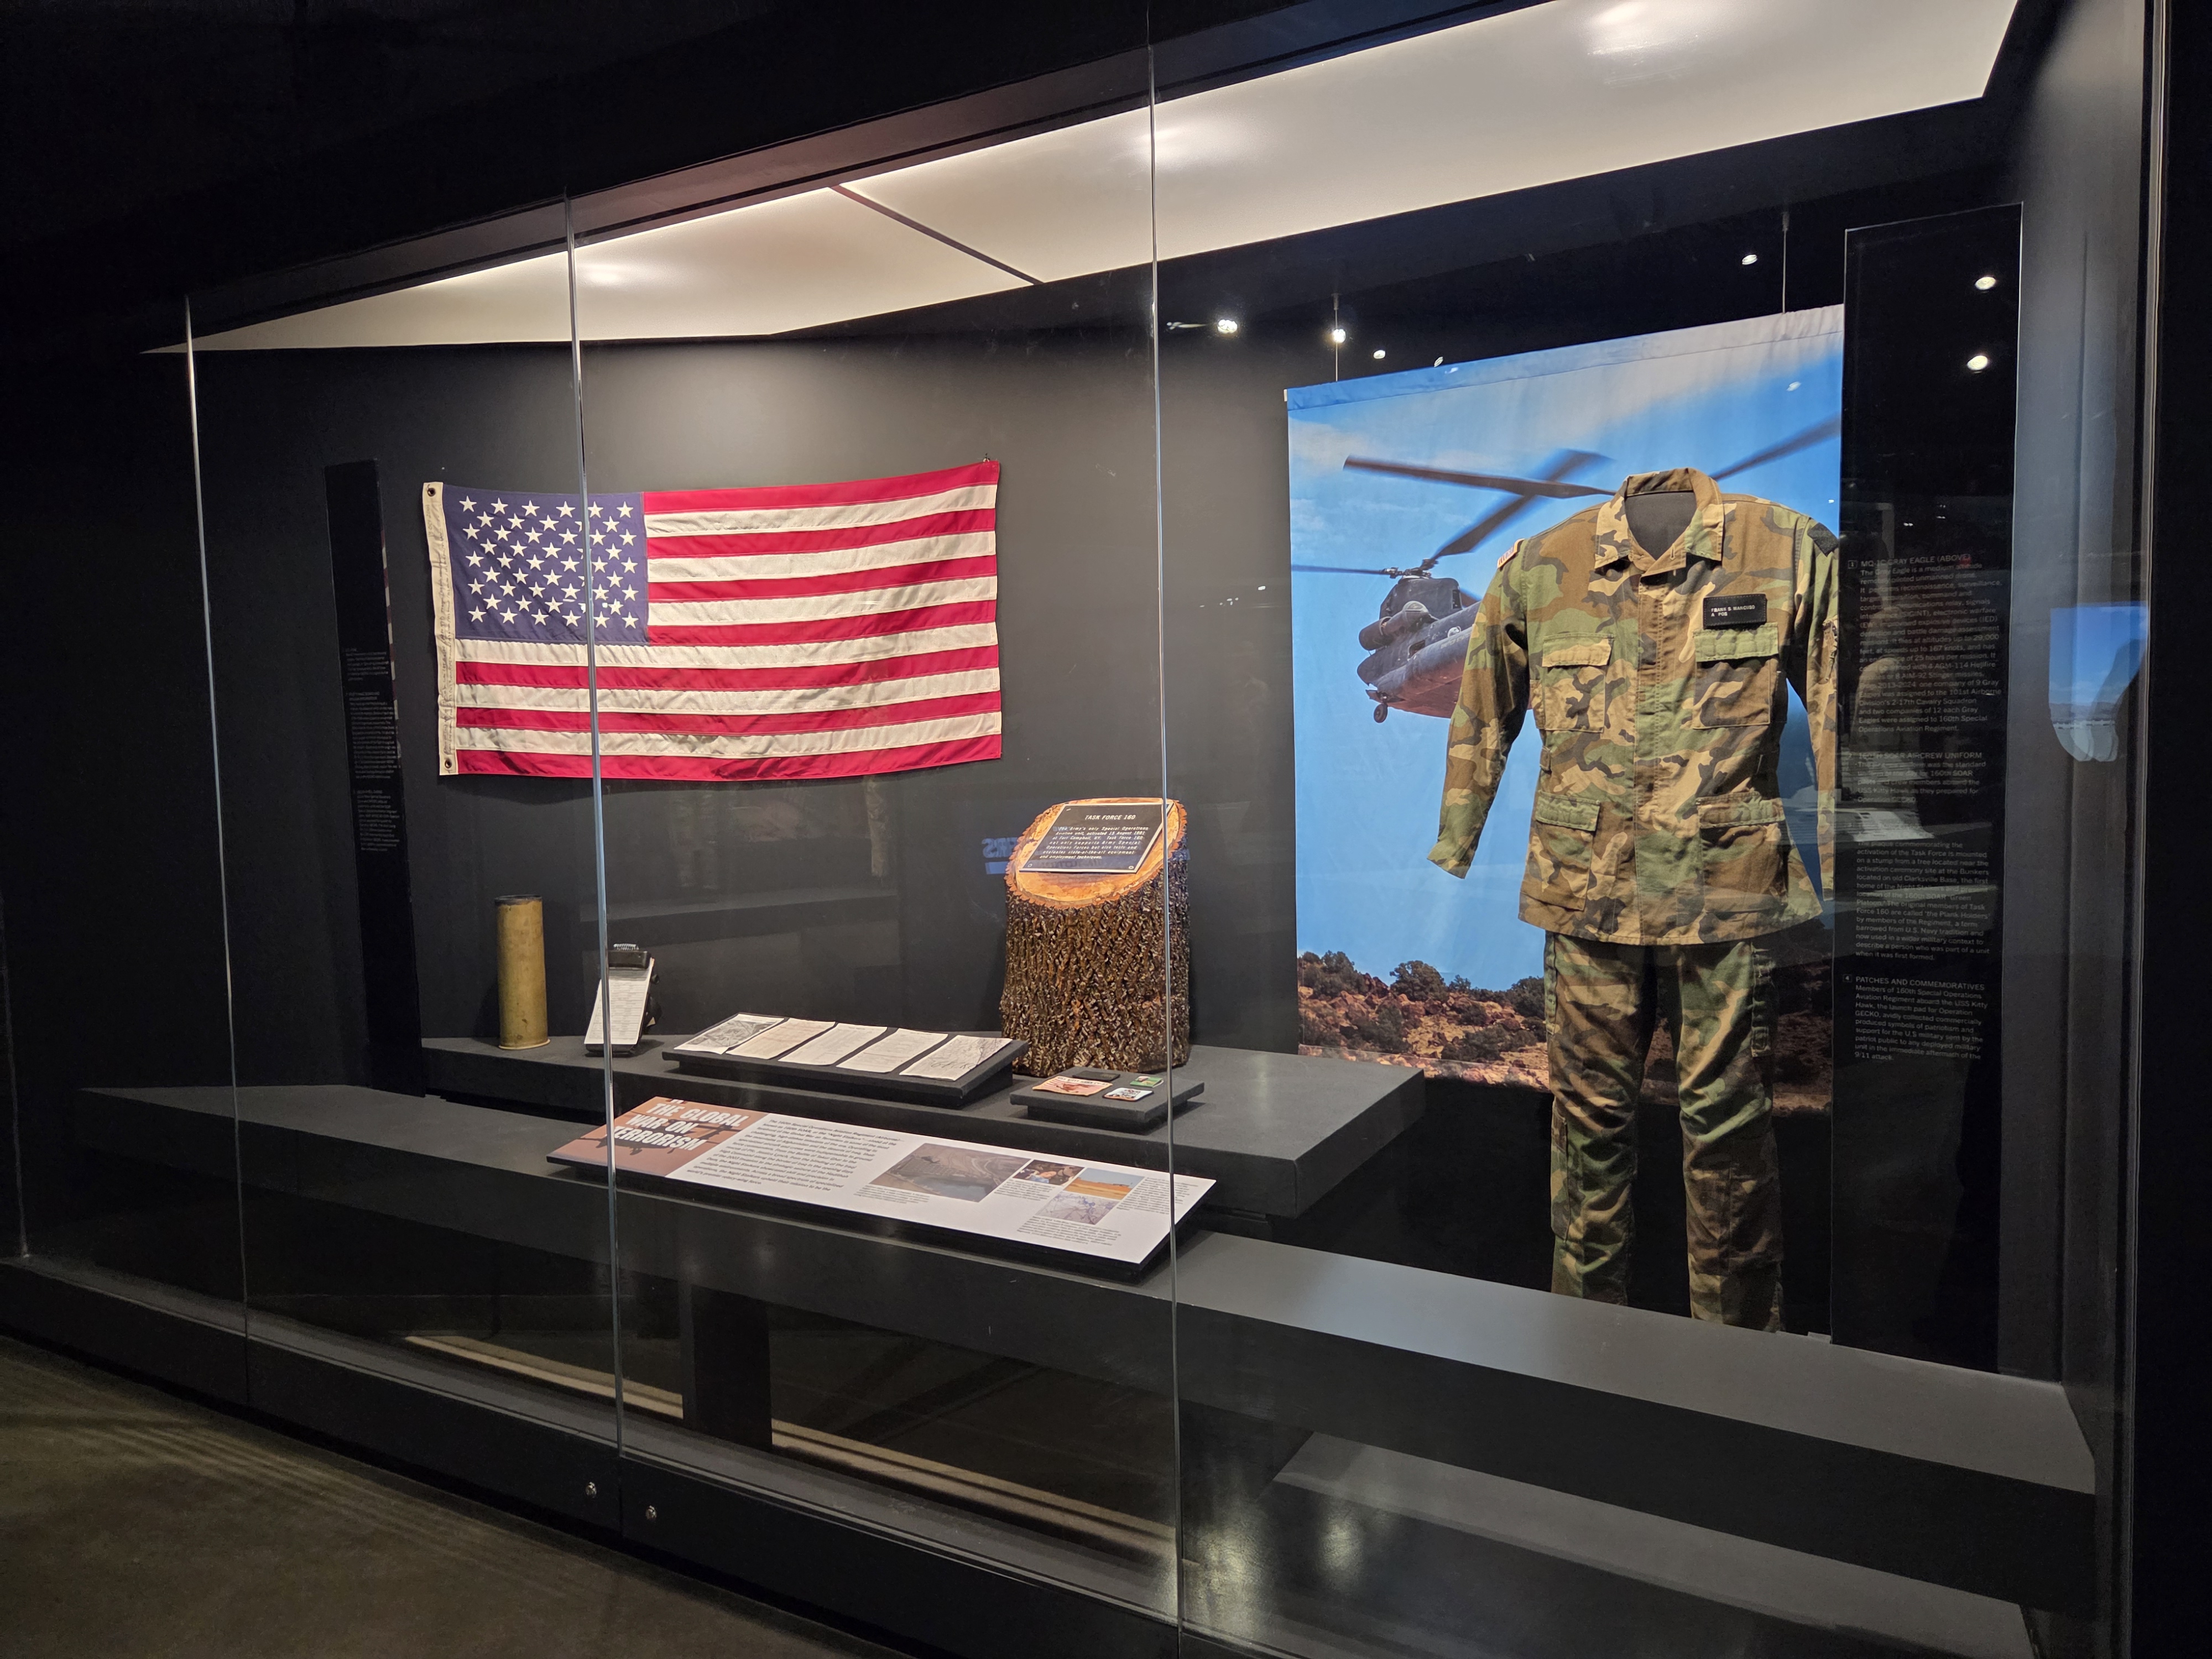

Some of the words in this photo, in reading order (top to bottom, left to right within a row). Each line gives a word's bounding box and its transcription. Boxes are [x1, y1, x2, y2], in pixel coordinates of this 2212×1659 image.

[1910, 980, 1985, 990] COMMEMORATIVES
[1883, 995, 1914, 1004] Regiment
[1971, 1001, 1987, 1009] Kitty
[1936, 1016, 1981, 1025] commercially
[1919, 1031, 1944, 1040] military
[1890, 1046, 1924, 1055] immediate
[1922, 1041, 1953, 1049] deployed
[1955, 1043, 1981, 1052] military
[646, 1103, 686, 1117] THE
[680, 1108, 750, 1127] GLOBAL
[625, 1114, 669, 1129] WAR
[665, 1121, 699, 1134] ON
[614, 1126, 707, 1151] TERRORISM
